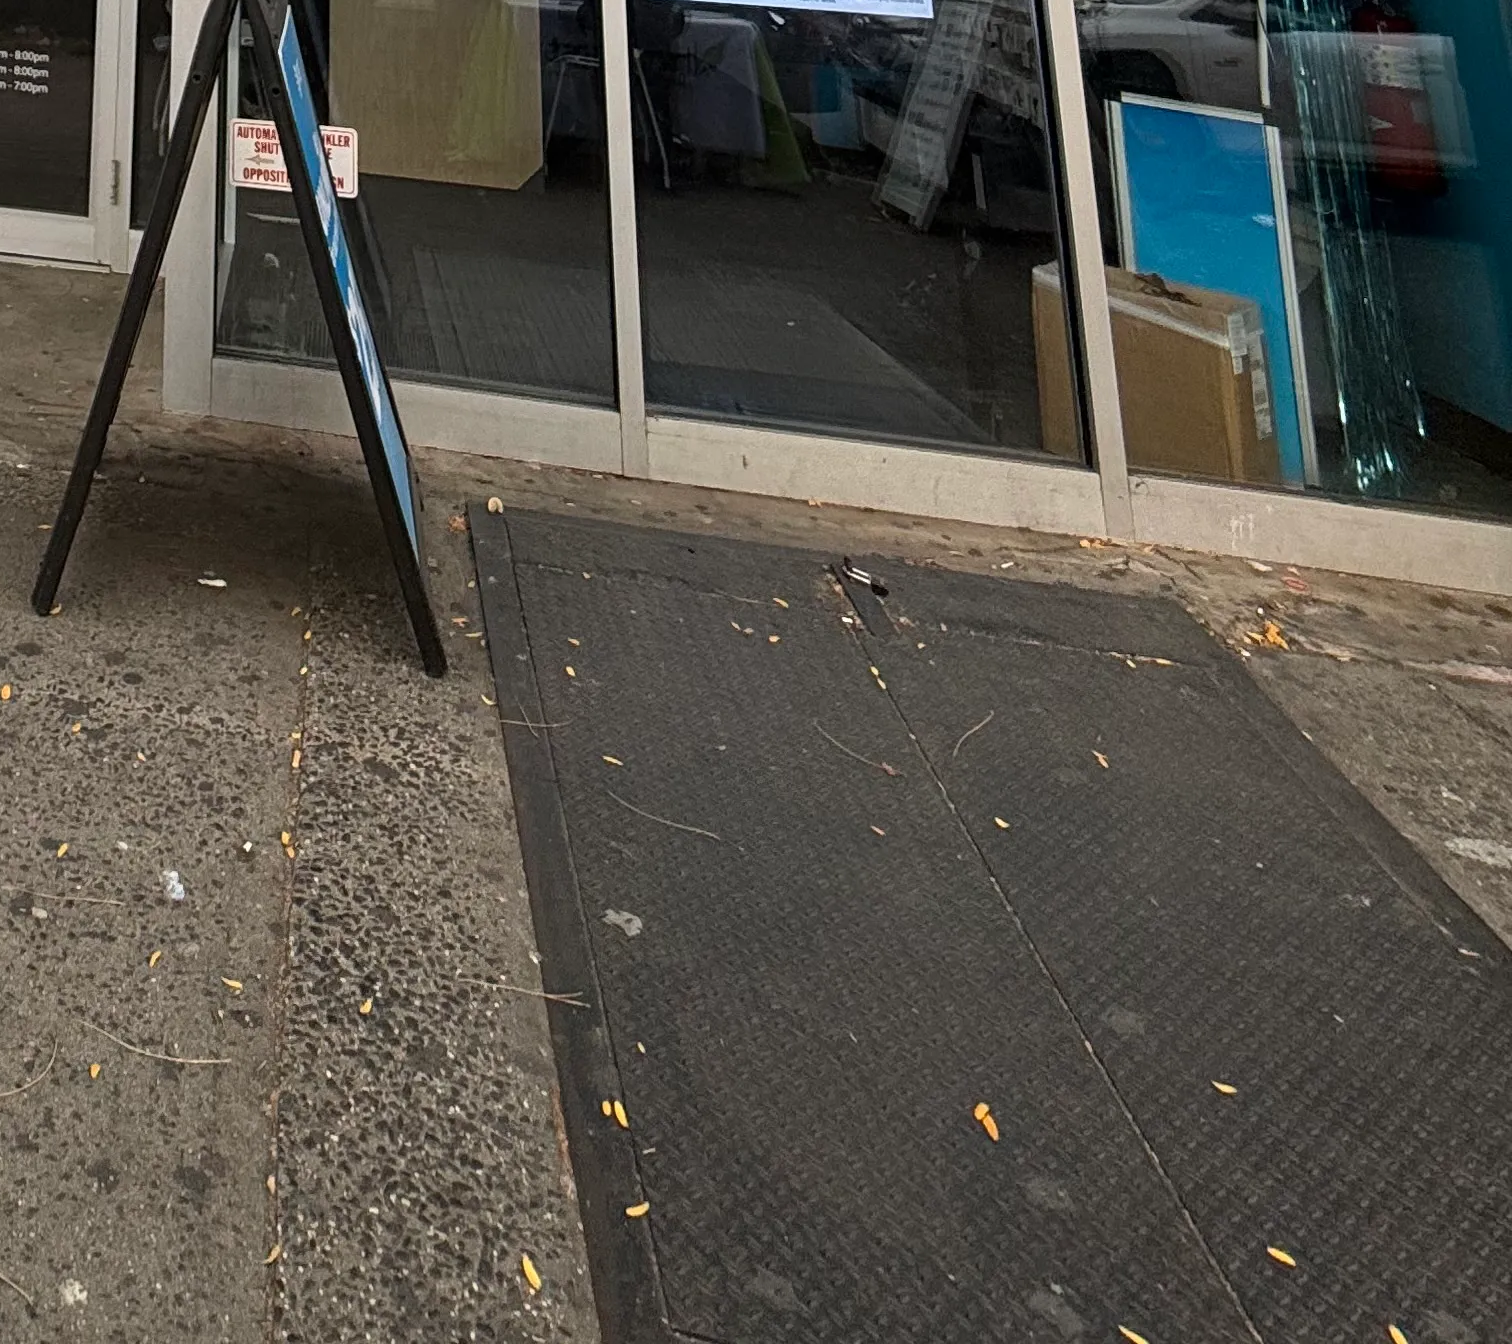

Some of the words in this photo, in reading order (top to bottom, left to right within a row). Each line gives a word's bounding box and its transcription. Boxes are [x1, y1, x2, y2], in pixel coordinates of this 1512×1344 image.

[14, 49, 50, 64] 8:00pm
[14, 65, 49, 79] 8:00pm
[14, 80, 49, 94] 7:00pm
[237, 126, 278, 140] AUTOMA
[254, 142, 280, 155] SHUT
